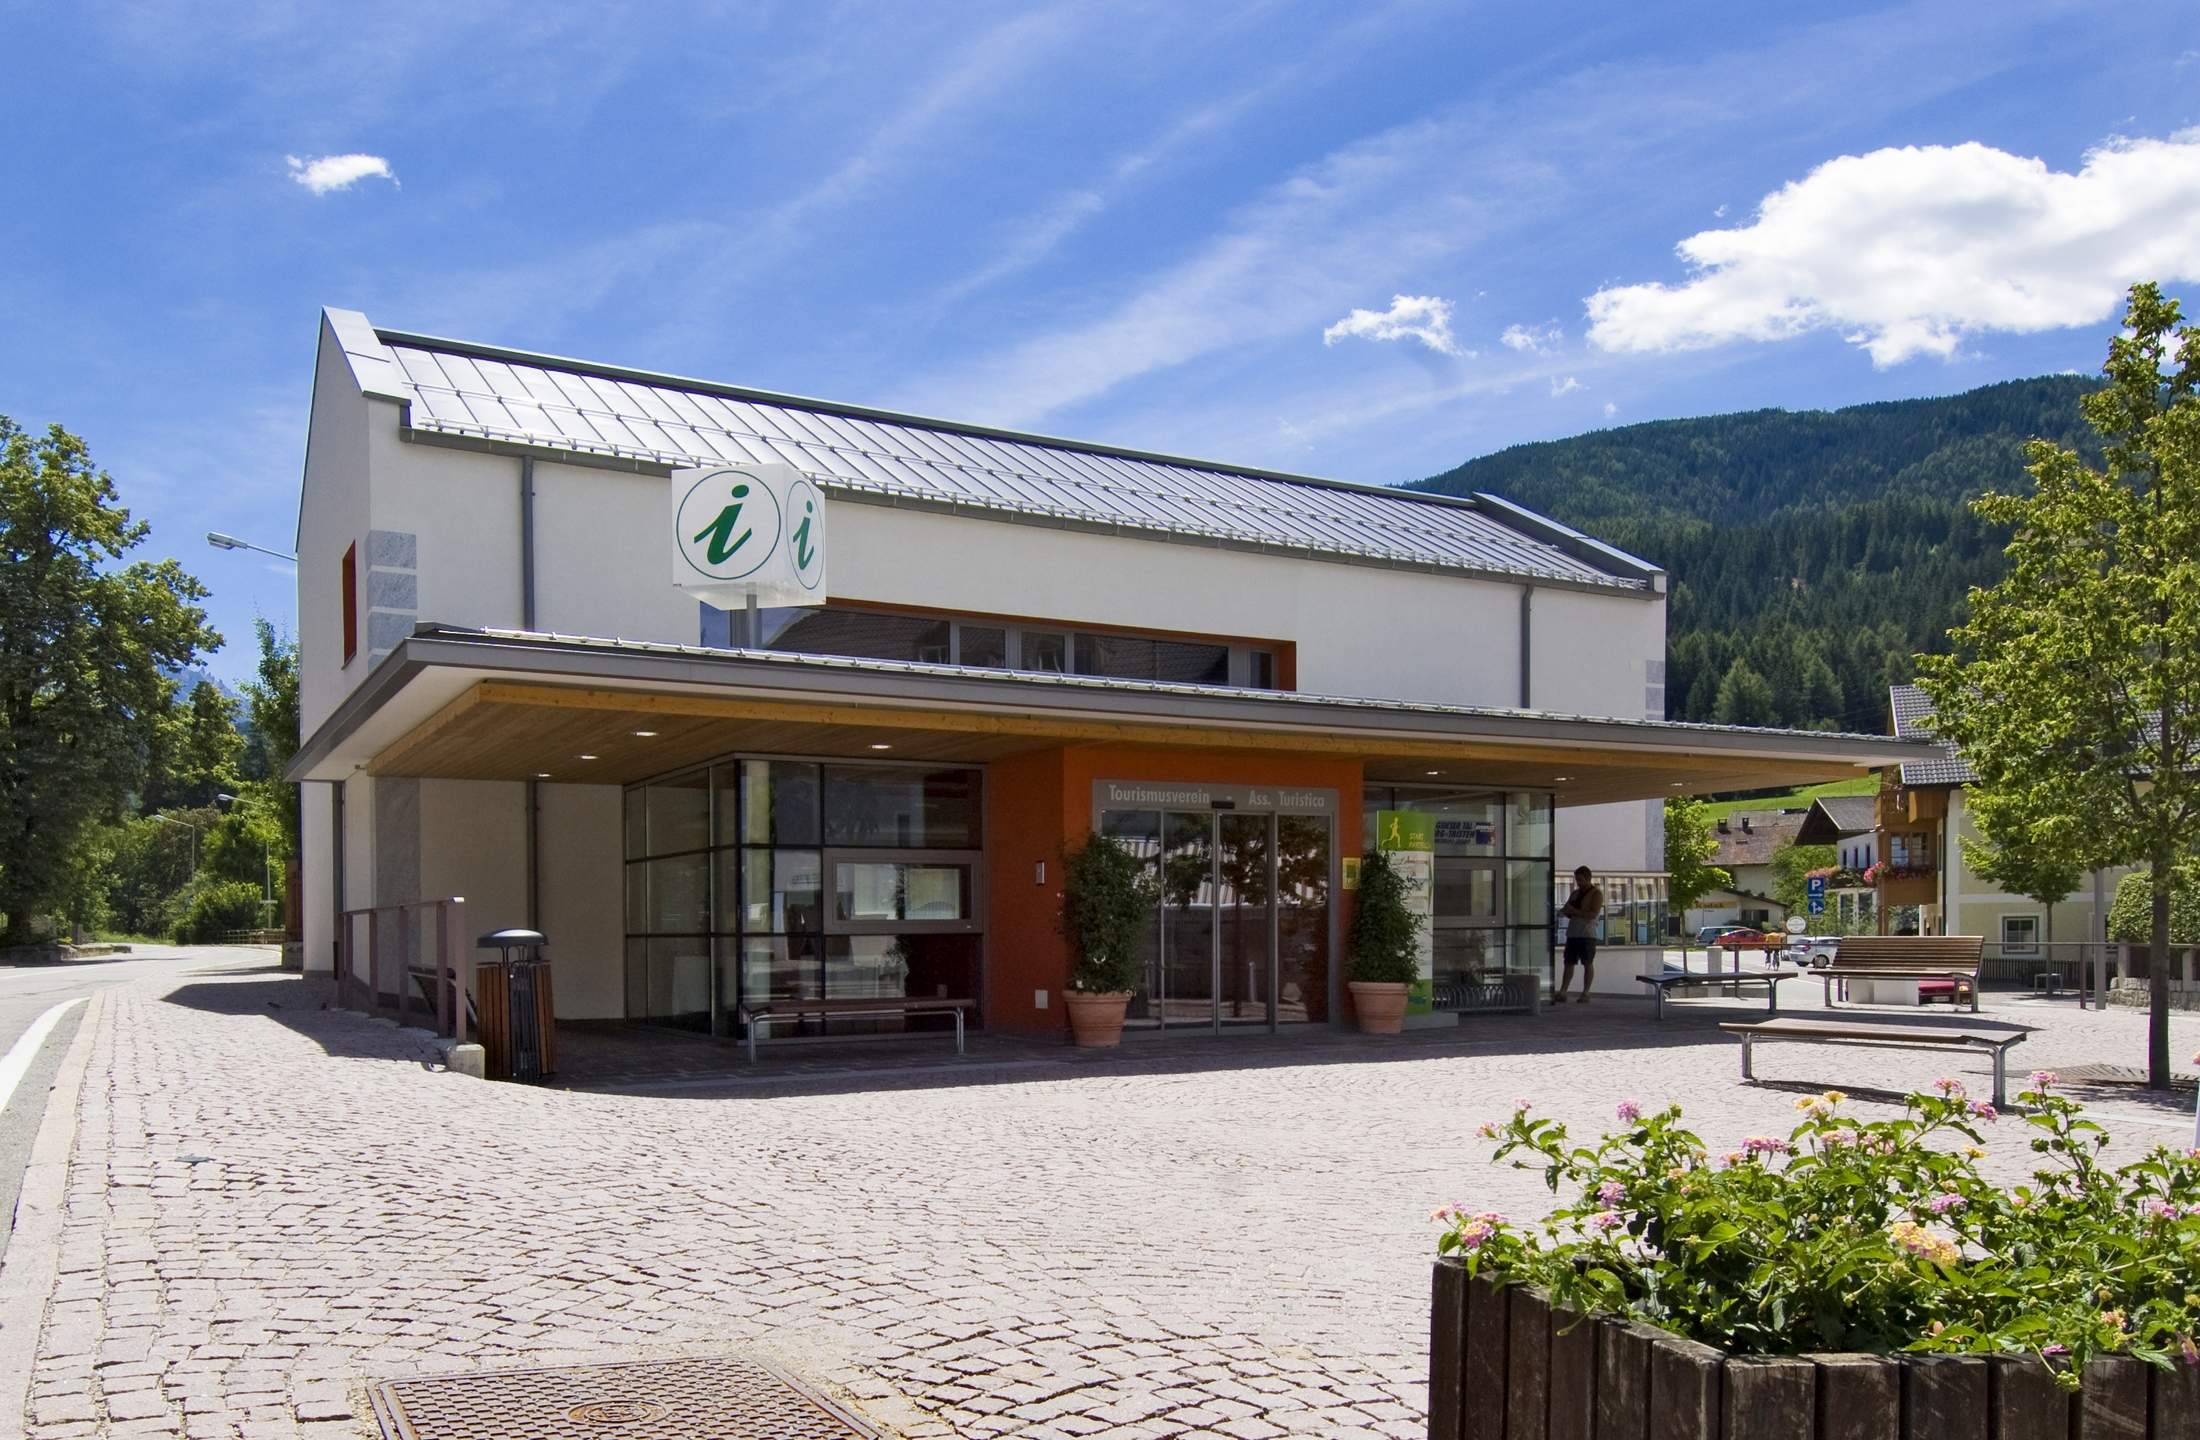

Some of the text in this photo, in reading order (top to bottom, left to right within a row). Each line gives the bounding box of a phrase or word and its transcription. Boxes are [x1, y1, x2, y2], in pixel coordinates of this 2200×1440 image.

[693, 484, 752, 565] i
[793, 500, 815, 571] i
[1108, 784, 1210, 804] Tourismusverein
[1248, 789, 1271, 806] Ass.
[1278, 791, 1325, 808] Turistica
[1811, 879, 1822, 891] P
